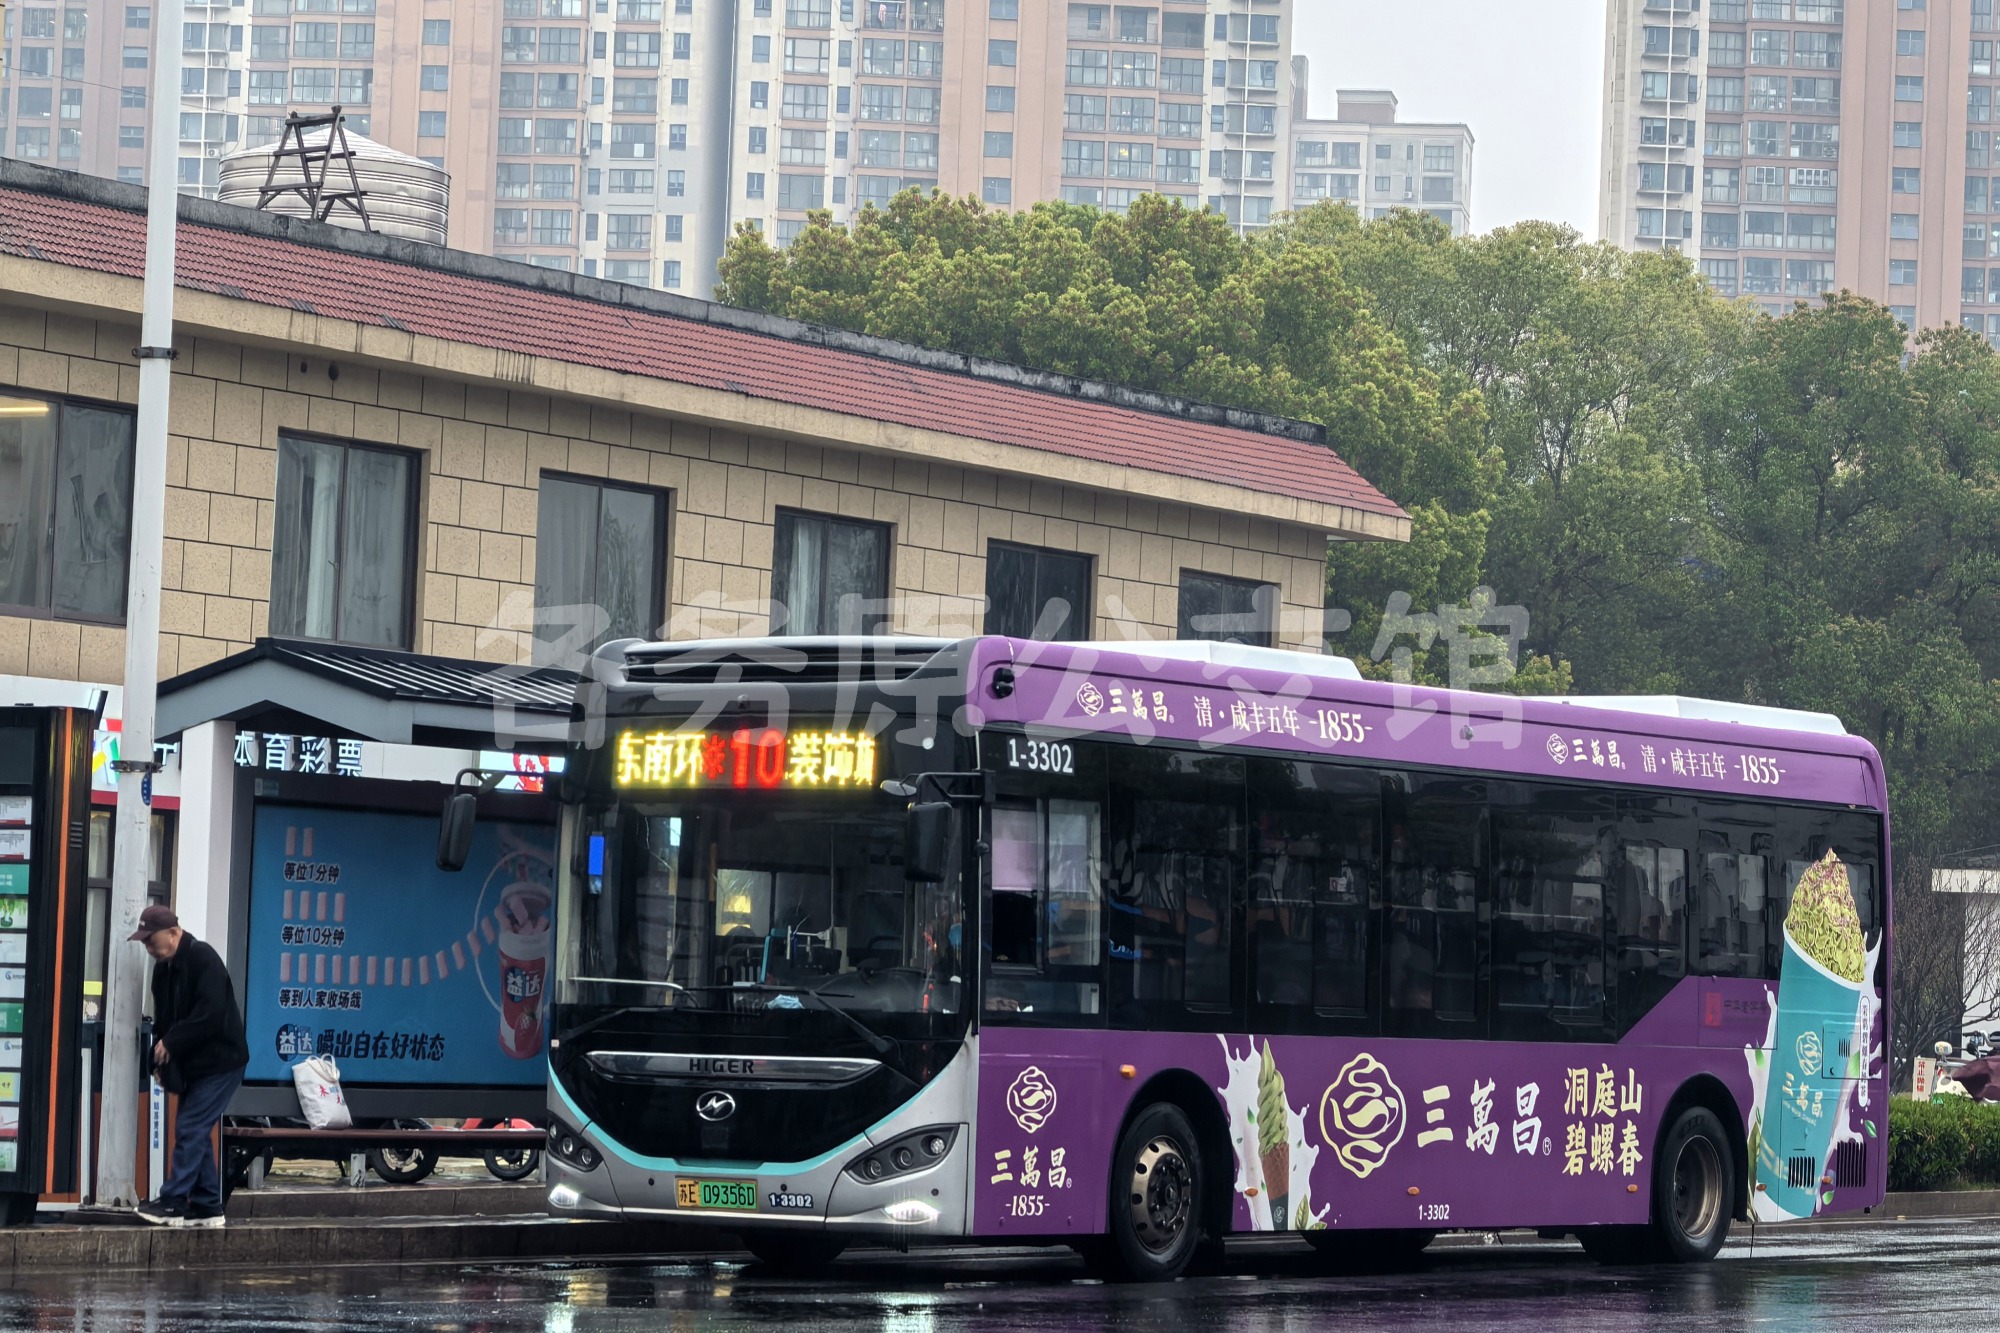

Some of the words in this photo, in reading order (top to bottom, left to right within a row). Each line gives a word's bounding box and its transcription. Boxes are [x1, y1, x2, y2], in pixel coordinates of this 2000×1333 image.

[1008, 739, 1074, 775] 1-3302
[284, 861, 340, 884] 等位1分钟
[281, 925, 346, 948] 等位10分钟
[506, 972, 541, 997] 益达
[279, 1030, 314, 1055] 益达
[316, 1028, 446, 1062] 嚼出自在好状态
[689, 1058, 754, 1074] HIGER
[1563, 1062, 1643, 1118] 洞庭山
[1561, 1119, 1644, 1177] 碧螺春
[1418, 1204, 1450, 1221] 1-3302
